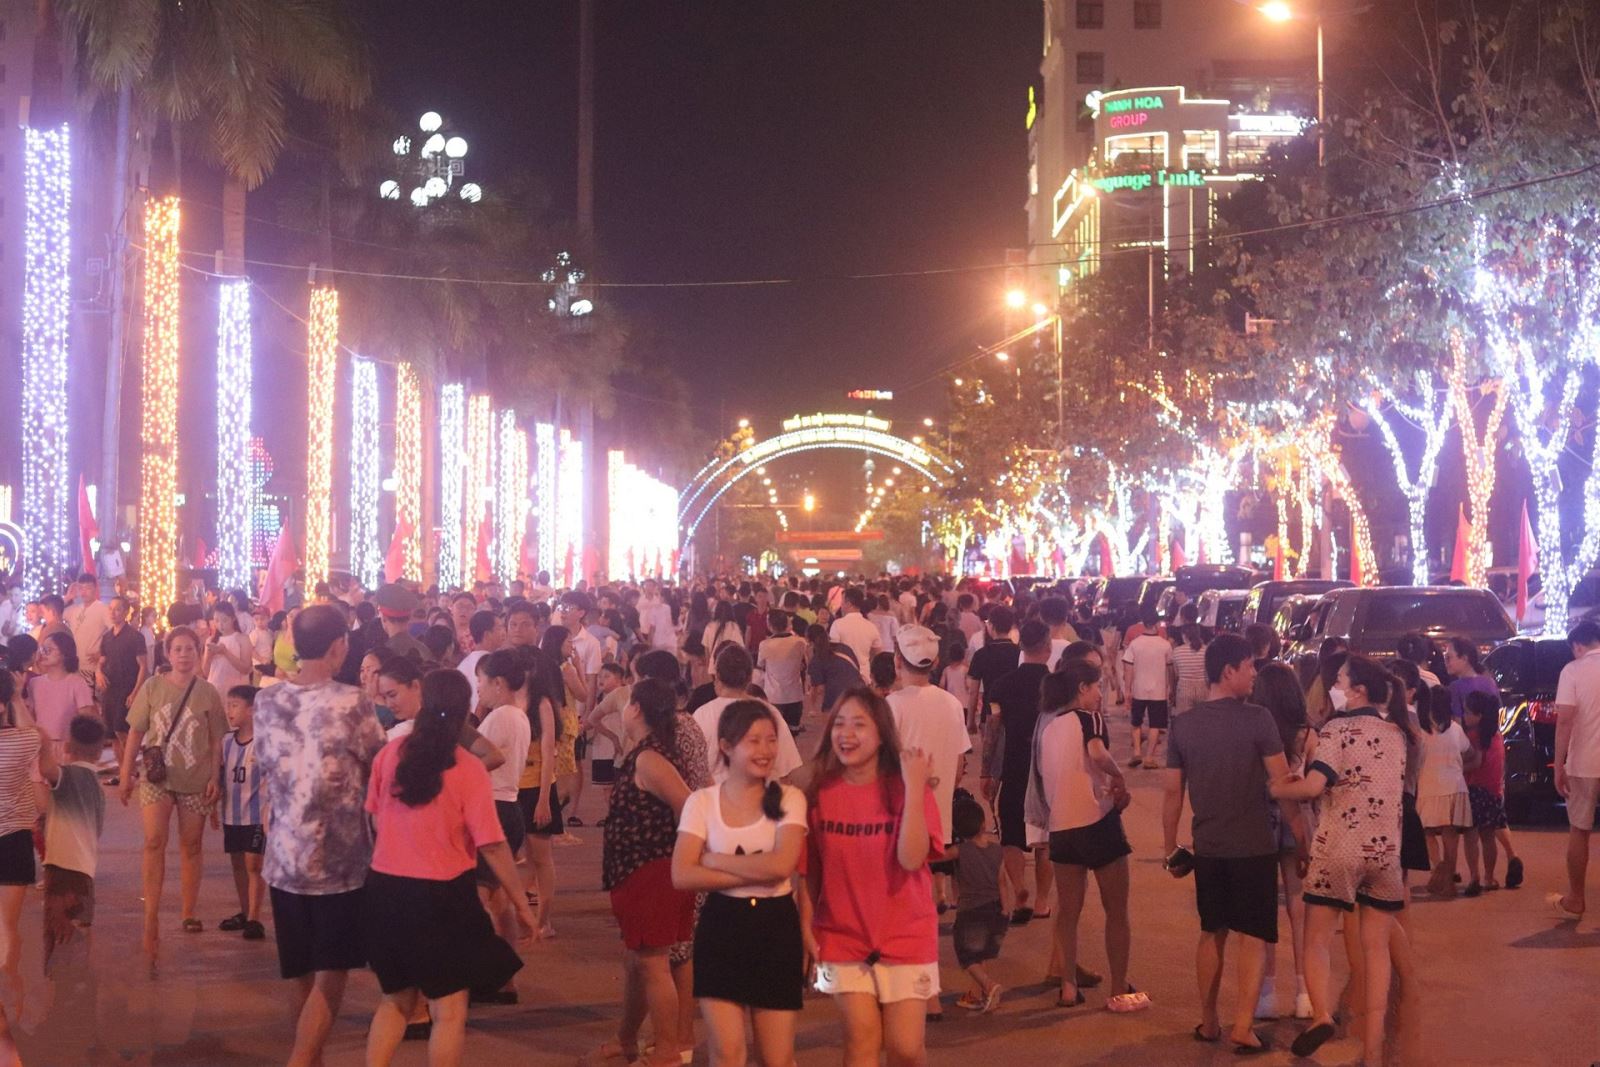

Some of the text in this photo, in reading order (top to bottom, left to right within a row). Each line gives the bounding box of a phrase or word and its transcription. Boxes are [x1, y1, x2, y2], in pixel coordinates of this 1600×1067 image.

[1135, 96, 1163, 109] HOA
[1111, 113, 1147, 128] GROUP
[232, 766, 246, 784] 10
